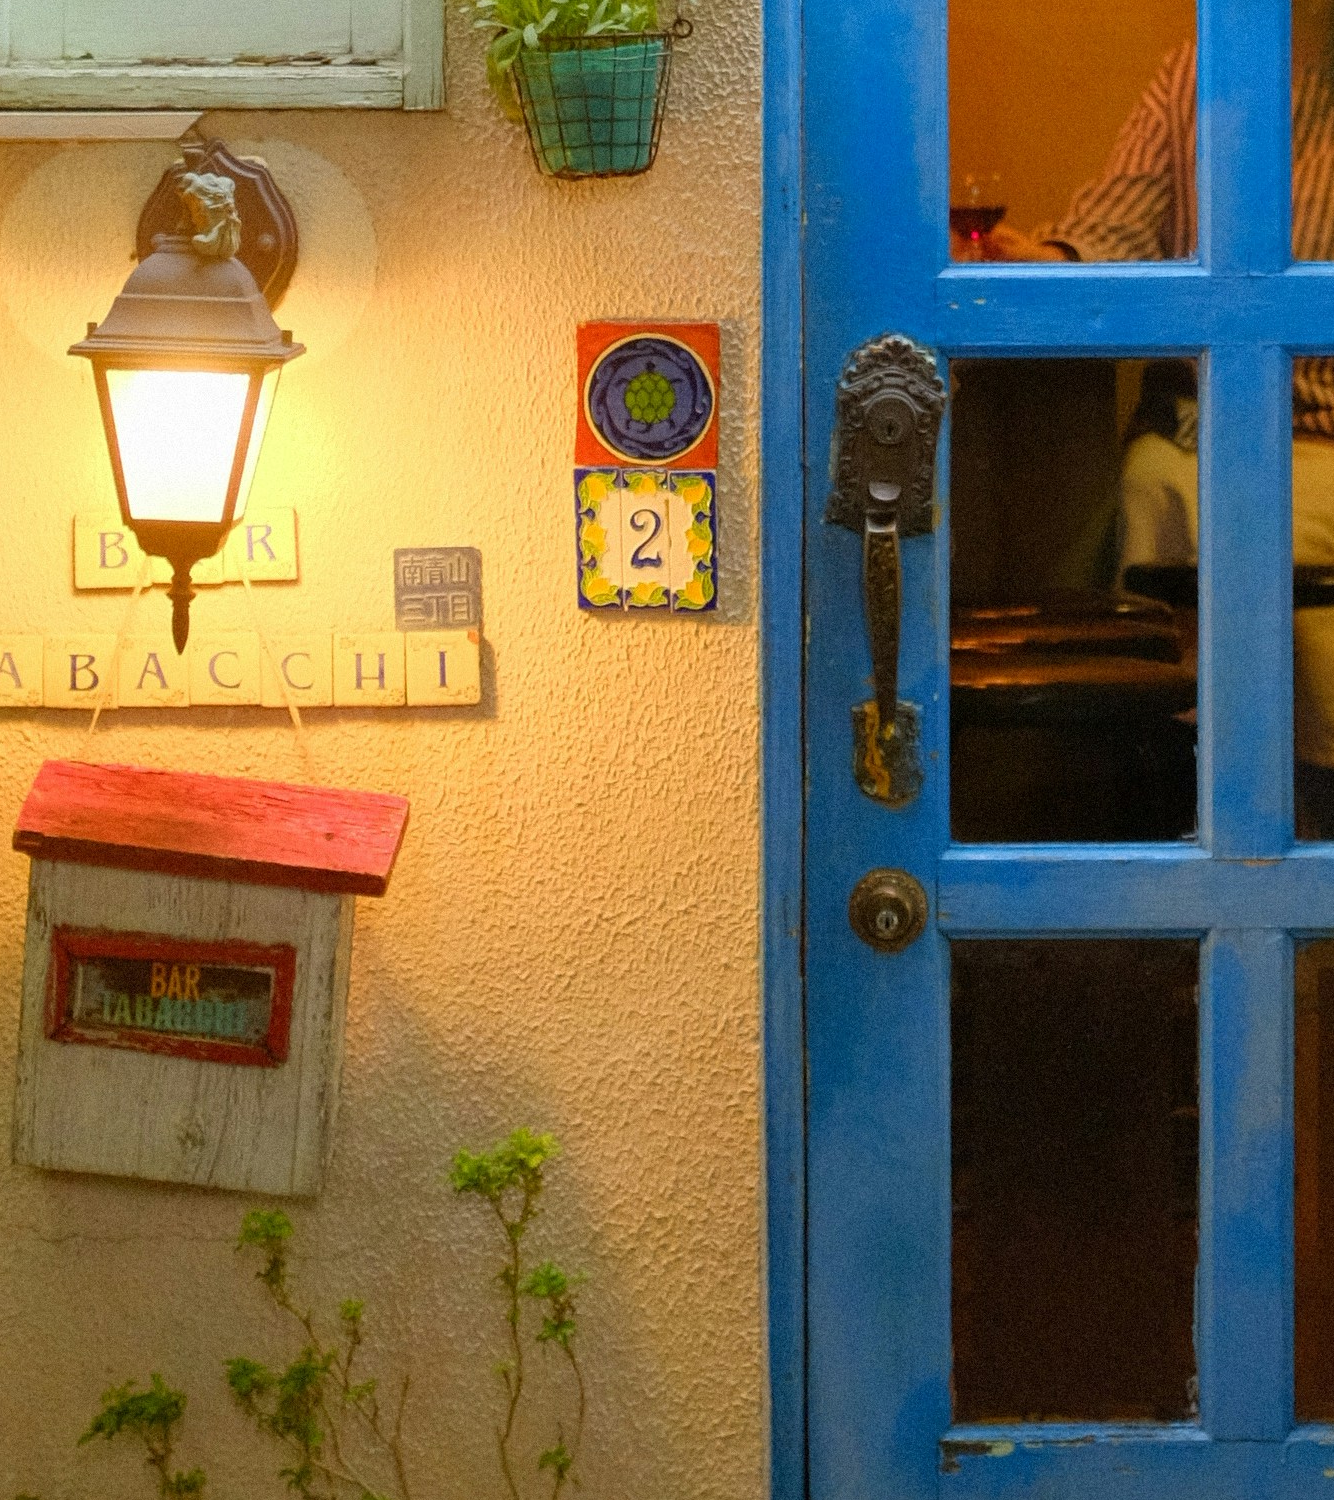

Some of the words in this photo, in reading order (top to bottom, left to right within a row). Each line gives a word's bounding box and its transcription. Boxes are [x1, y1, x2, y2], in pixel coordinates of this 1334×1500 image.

[98, 524, 276, 569] BR
[628, 508, 665, 567] 2
[401, 554, 471, 587] 南青山
[402, 592, 473, 624] 三丁目
[151, 962, 201, 1001] BAR
